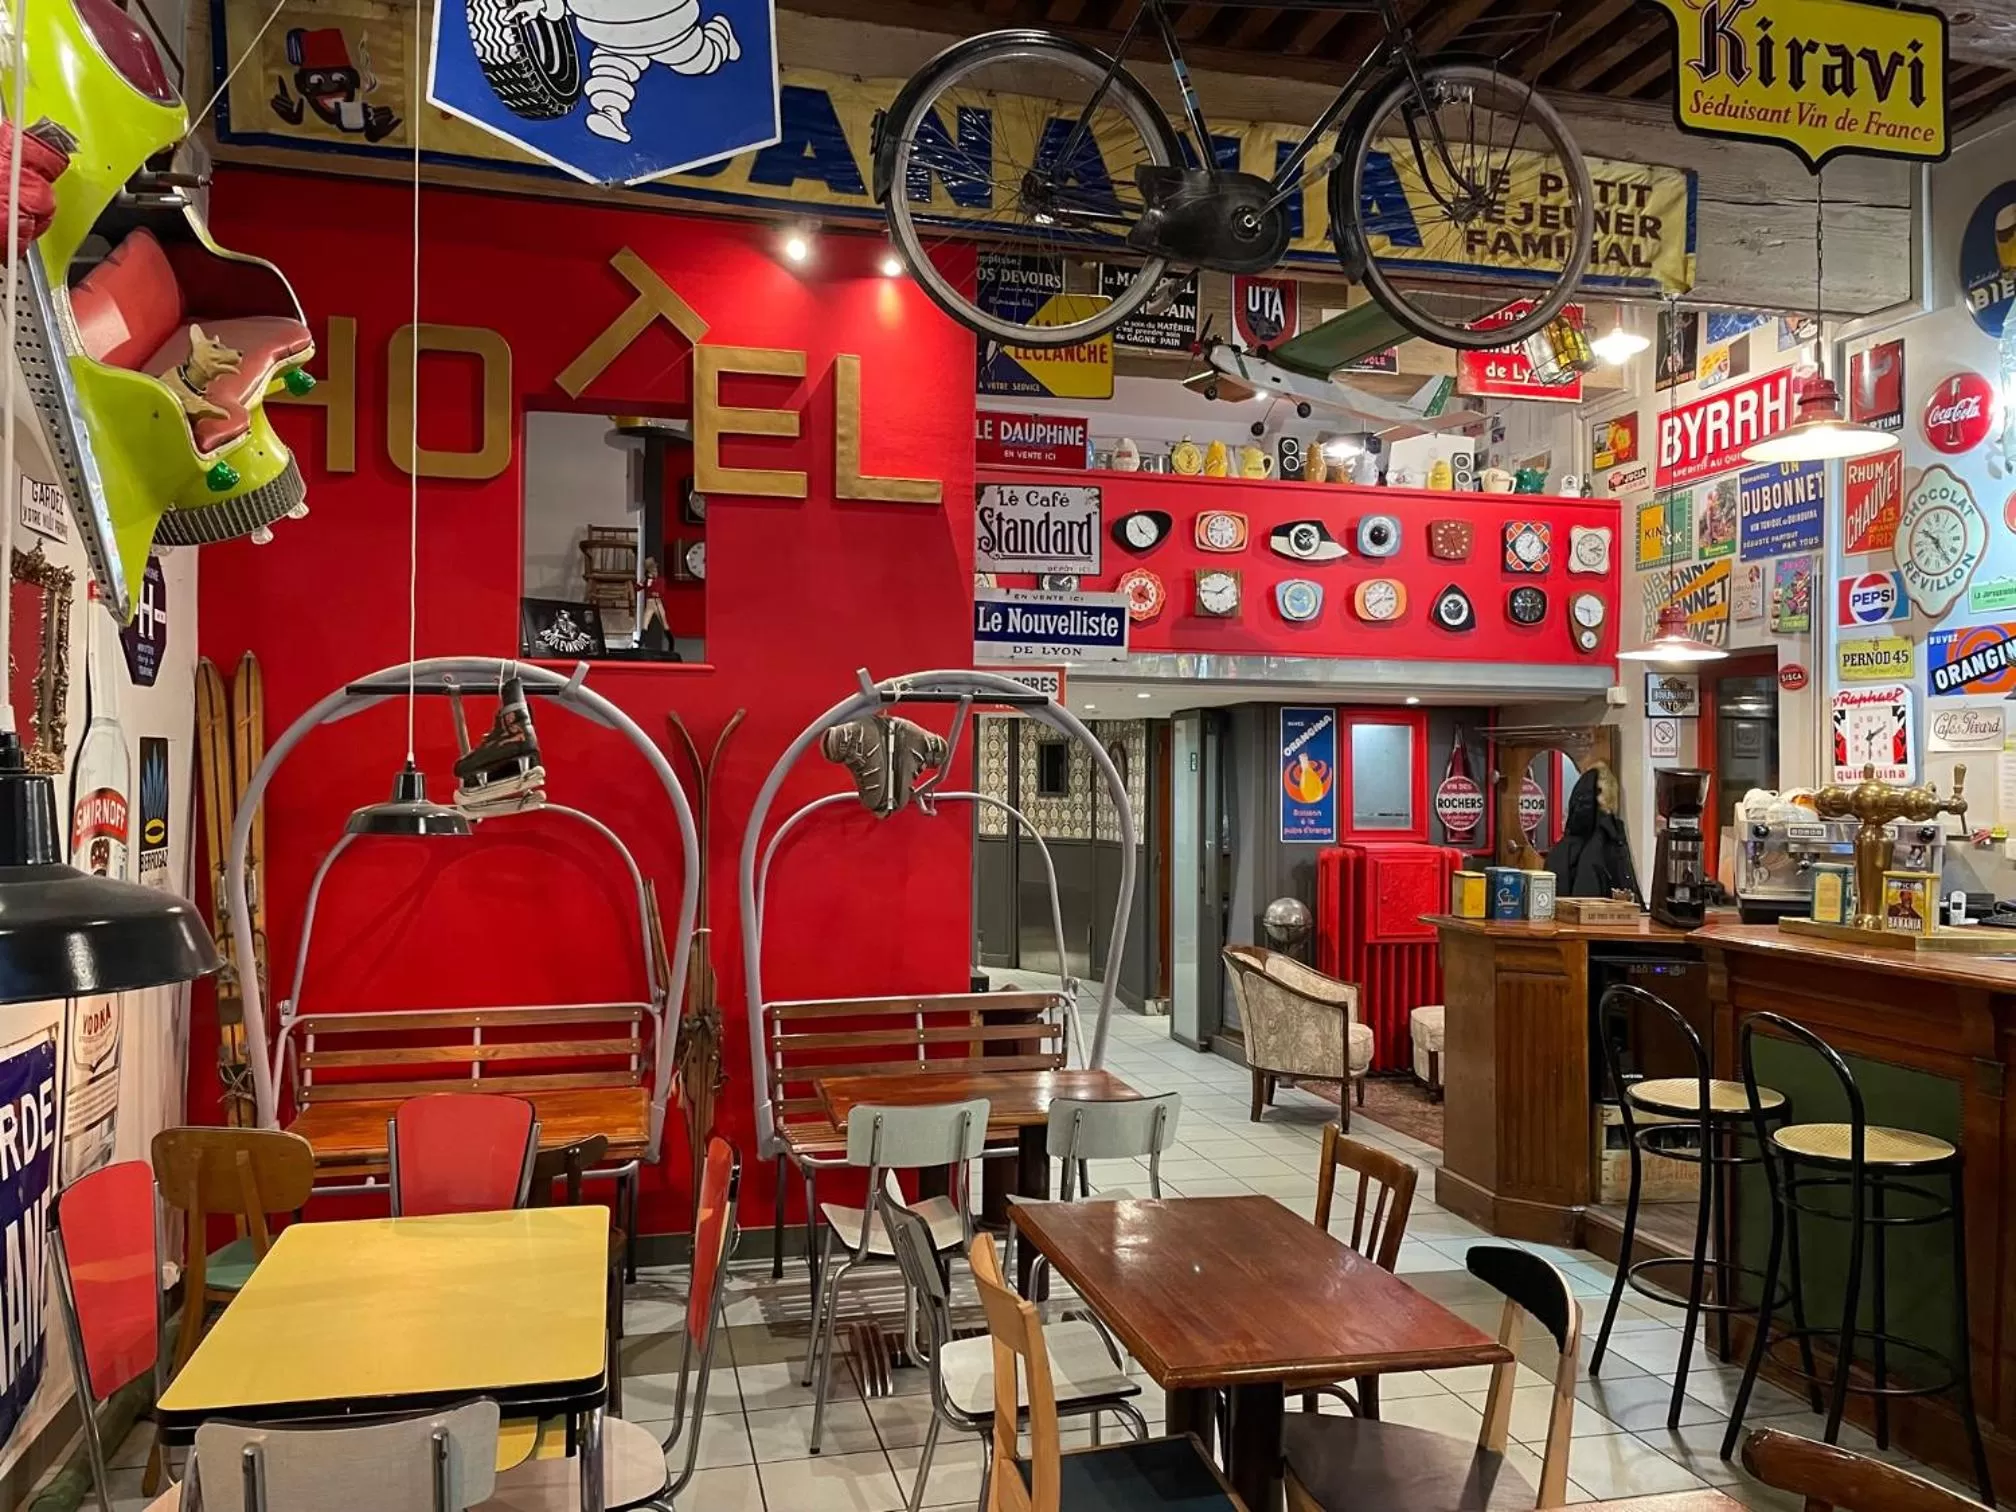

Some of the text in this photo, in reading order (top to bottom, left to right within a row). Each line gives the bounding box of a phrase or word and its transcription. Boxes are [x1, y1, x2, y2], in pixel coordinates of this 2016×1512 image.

[1685, 0, 1927, 109] Kiravi
[1689, 90, 1935, 143] Séduisant Vin de France
[1539, 172, 1653, 208] PTIT
[1001, 268, 1062, 289] DEVOIRS
[1248, 285, 1286, 329] UTA
[1486, 361, 1507, 378] de
[975, 419, 993, 440] LE
[1660, 376, 1788, 469] BYRRH
[1004, 449, 1014, 459] EN
[1017, 451, 1042, 461] VENTE
[1711, 459, 1722, 468] AU
[1849, 462, 1884, 484] RHUM
[32, 482, 64, 516] GARDEZ
[1000, 490, 1070, 508] Le Café
[1741, 471, 1824, 518] DUBONNET
[1847, 454, 1901, 550] CHAUVET
[1903, 488, 1975, 527] CHOCOLAT
[1903, 552, 1976, 593] REVILLON
[1852, 589, 1895, 607] PEPSI
[978, 607, 1119, 638] Le Nouvelliste
[1012, 646, 1082, 656] DE LYON
[1843, 650, 1909, 668] PERNOD 45
[1284, 715, 1332, 757] ORANGINA
[75, 798, 127, 836] SMIRNOFF
[1438, 797, 1483, 809] ROCHERS
[83, 1002, 112, 1036] VODKA
